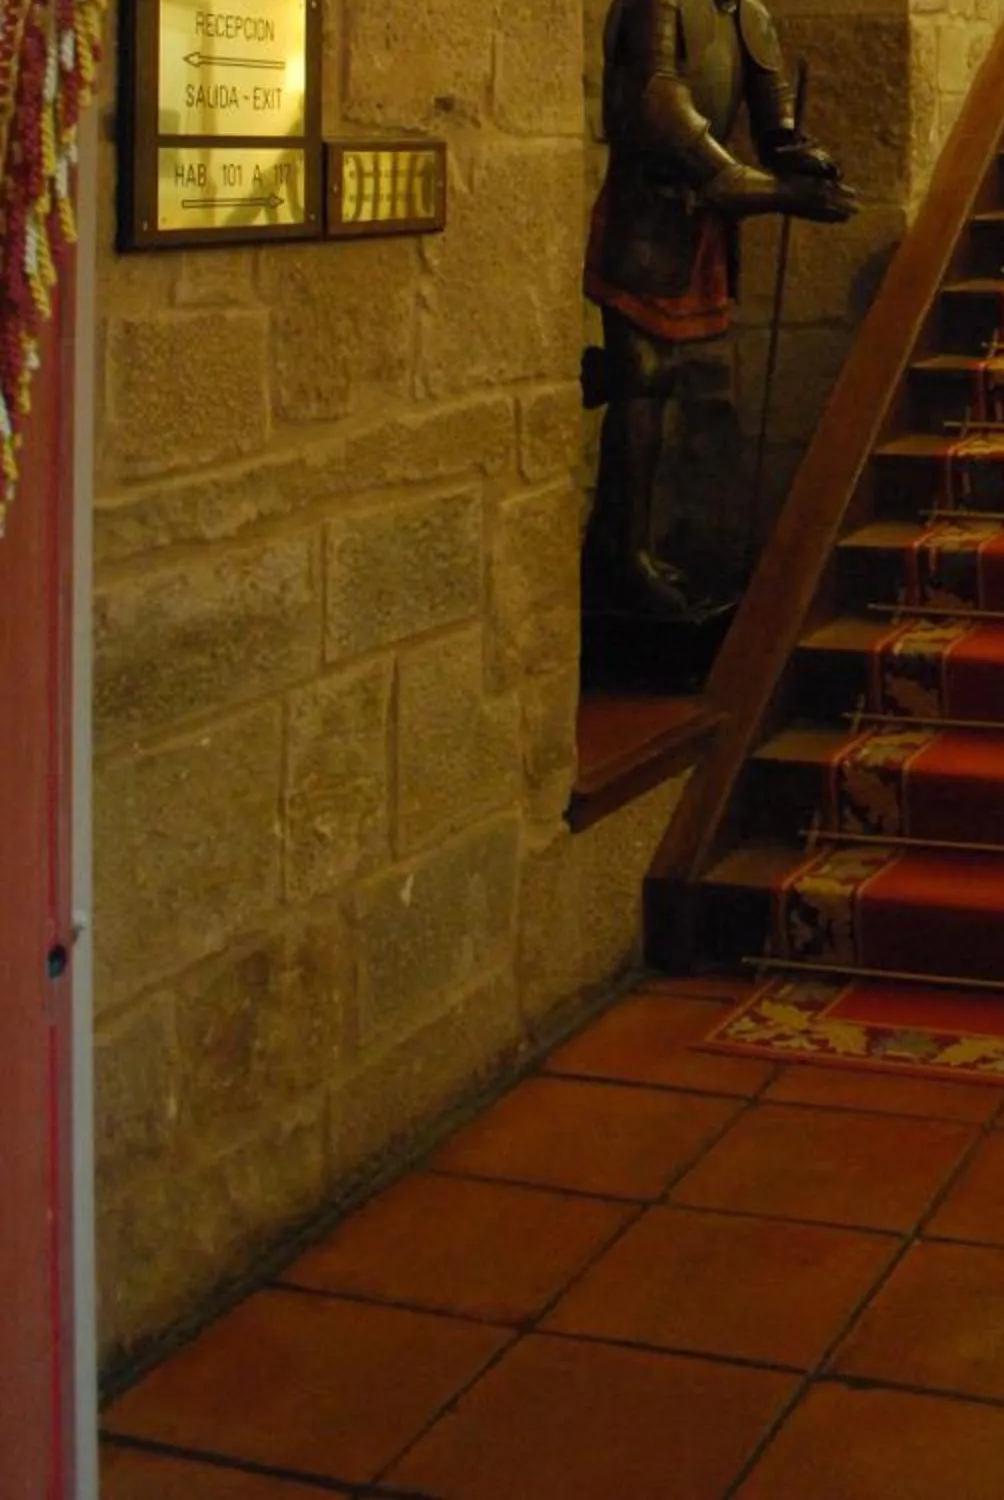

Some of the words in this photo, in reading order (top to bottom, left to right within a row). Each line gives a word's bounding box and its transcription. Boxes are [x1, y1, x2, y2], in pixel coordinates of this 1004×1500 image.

[195, 11, 275, 41] RECEPCION
[174, 163, 206, 188] HAB
[222, 164, 242, 187] 101
[252, 164, 263, 187] A
